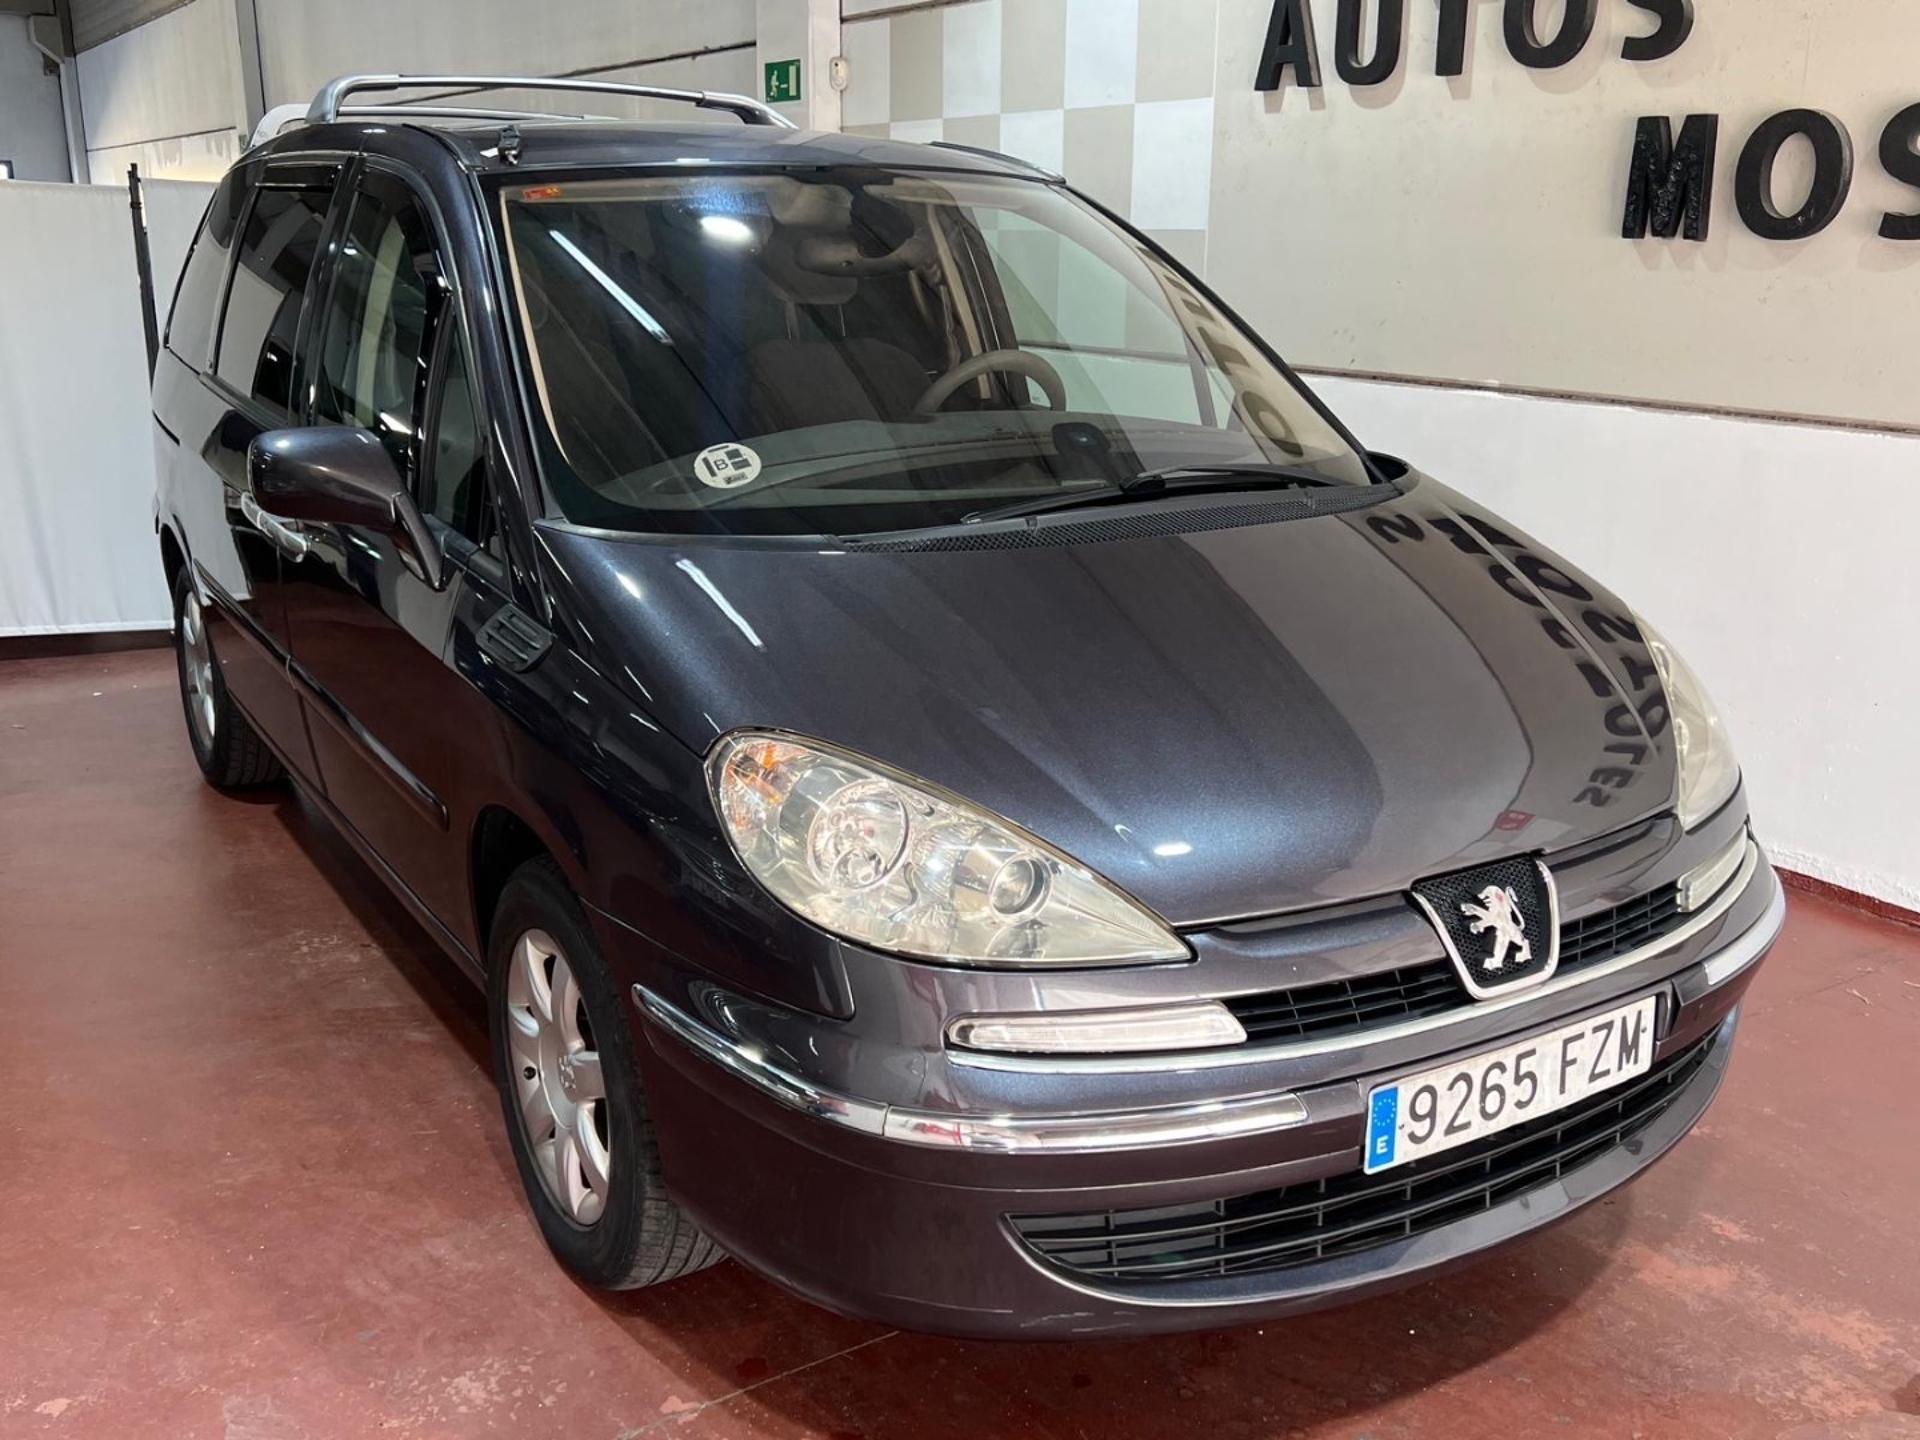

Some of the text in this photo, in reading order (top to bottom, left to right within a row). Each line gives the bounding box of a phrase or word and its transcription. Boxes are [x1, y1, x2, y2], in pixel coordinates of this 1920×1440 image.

[1406, 1009, 1643, 1145] 9265 FZM
[1376, 1135, 1389, 1155] E
